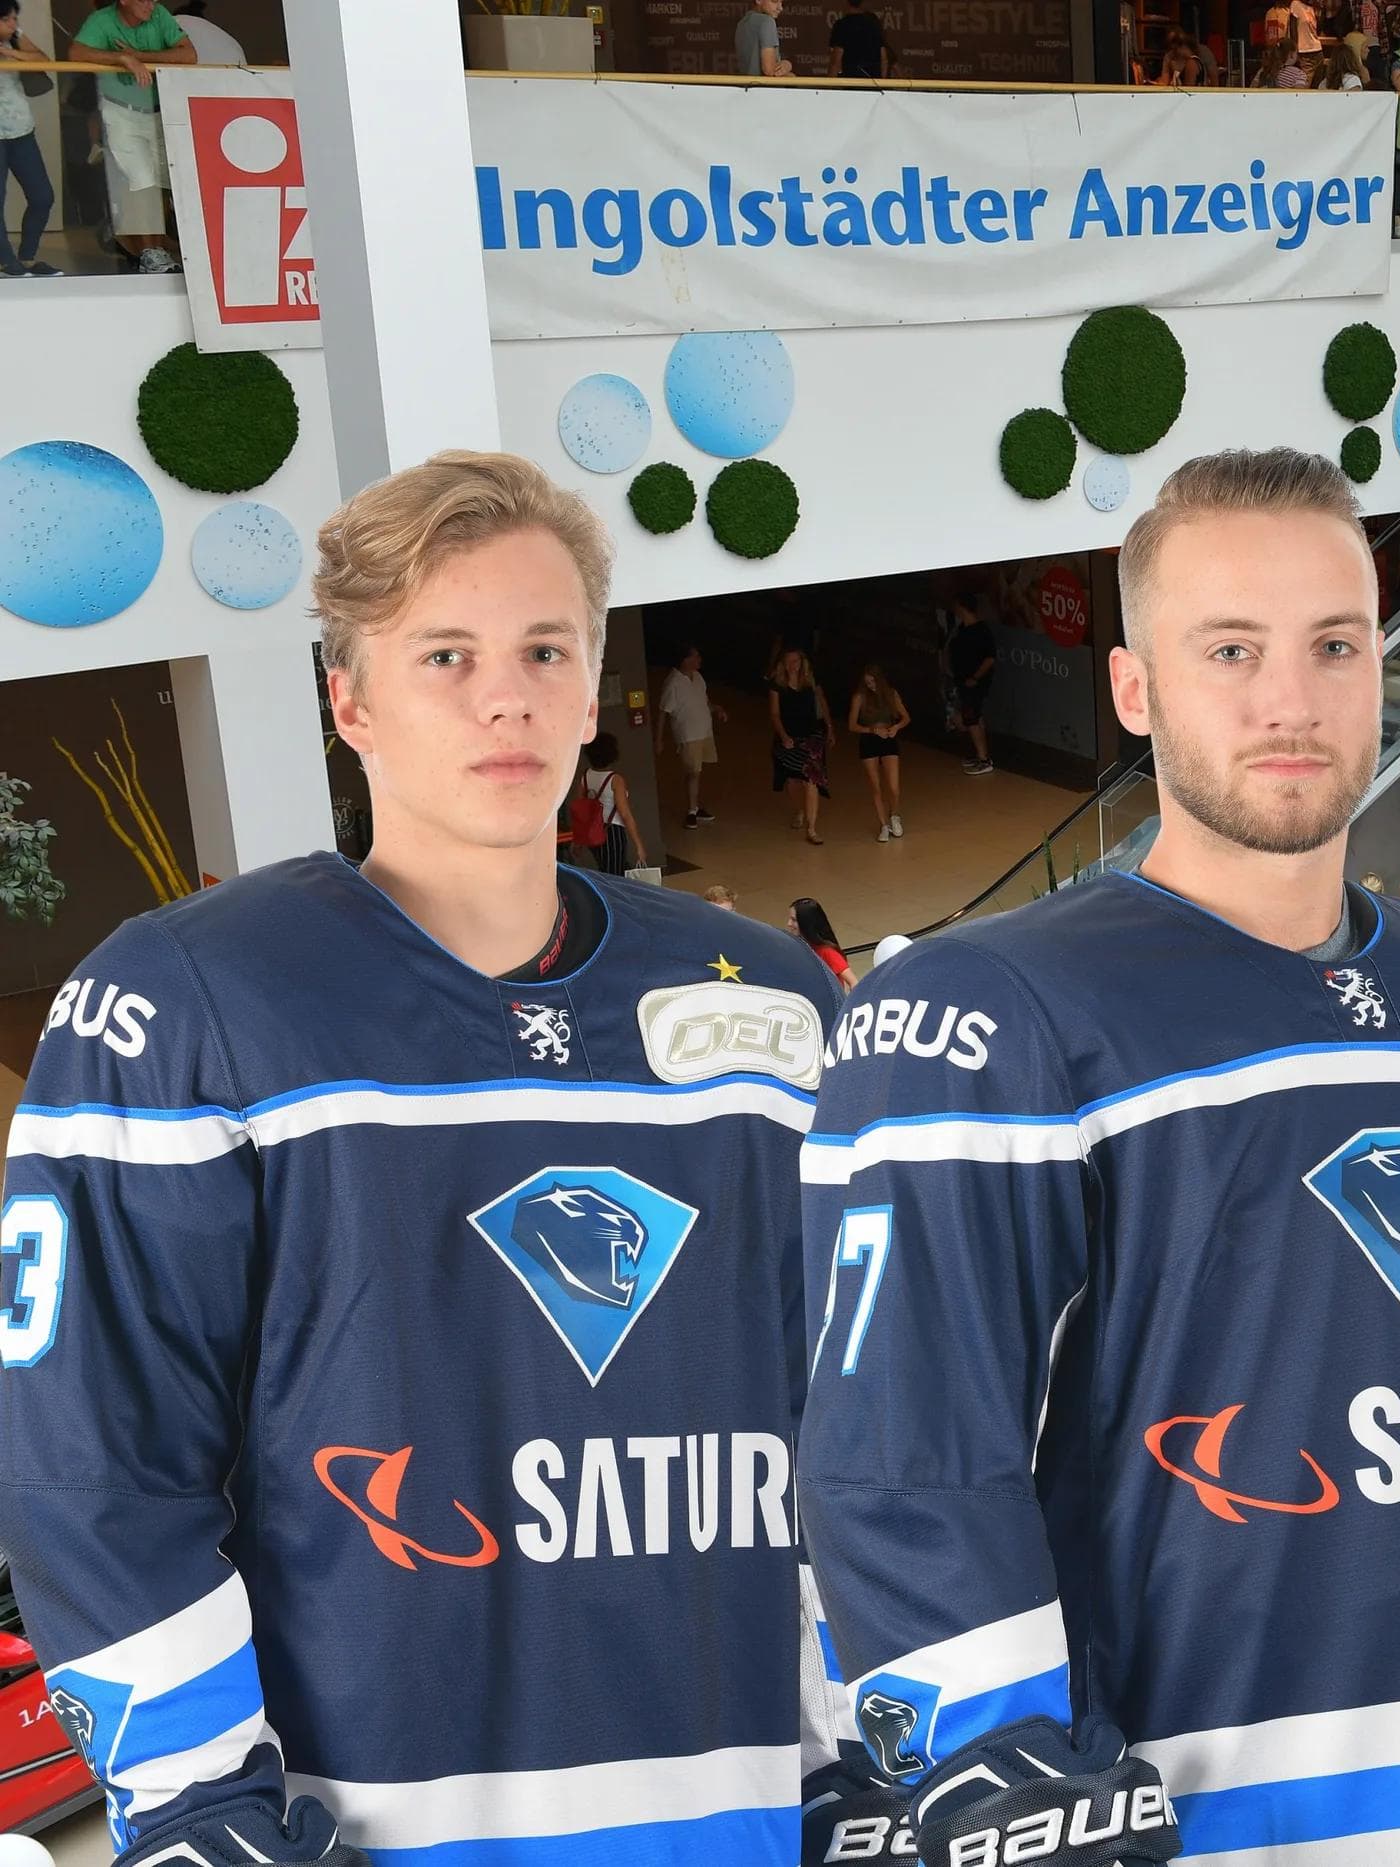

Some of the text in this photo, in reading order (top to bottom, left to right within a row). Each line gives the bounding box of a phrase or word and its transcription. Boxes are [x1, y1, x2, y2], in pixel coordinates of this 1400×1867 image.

[475, 159, 1385, 277] Ingolstädter Anzeiger
[1041, 590, 1086, 626] 50%
[39, 977, 158, 1059] BUS
[810, 1203, 894, 1384] 7
[511, 1431, 800, 1564] SATUR
